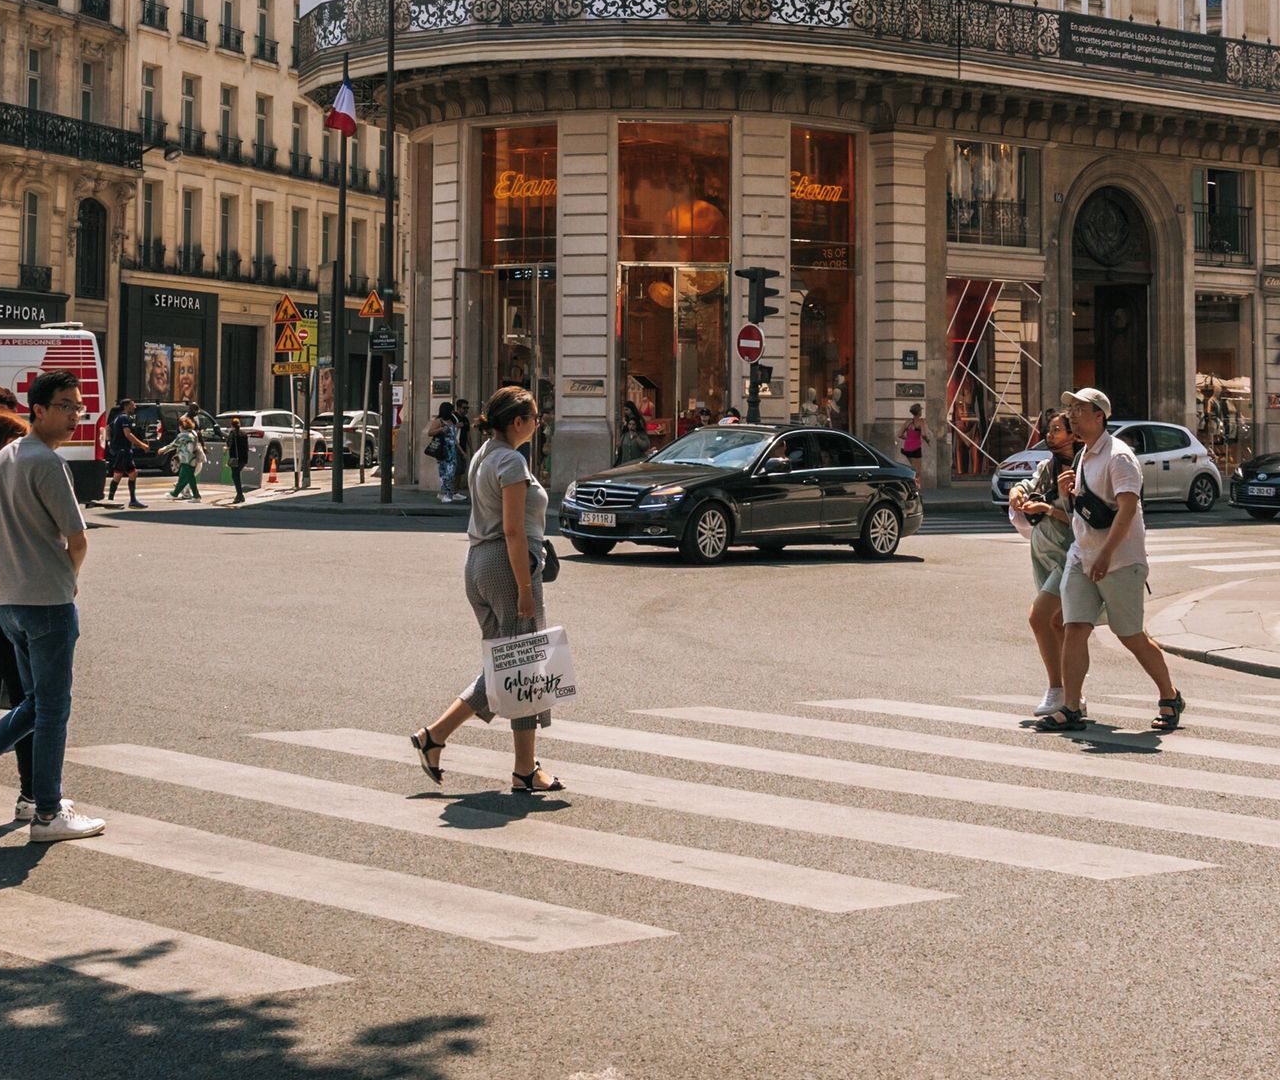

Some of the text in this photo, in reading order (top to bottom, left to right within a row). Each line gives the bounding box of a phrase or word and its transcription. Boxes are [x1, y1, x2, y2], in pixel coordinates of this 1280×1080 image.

[1078, 25, 1108, 35] application
[494, 171, 557, 199] Etam
[835, 248, 847, 258] OF
[154, 294, 201, 310] SEPHORA
[582, 513, 591, 522] ZS
[494, 637, 546, 654] THE DEPARTMENT
[494, 648, 533, 662] STORE THAT
[495, 652, 545, 669] NEVER SLEEPS
